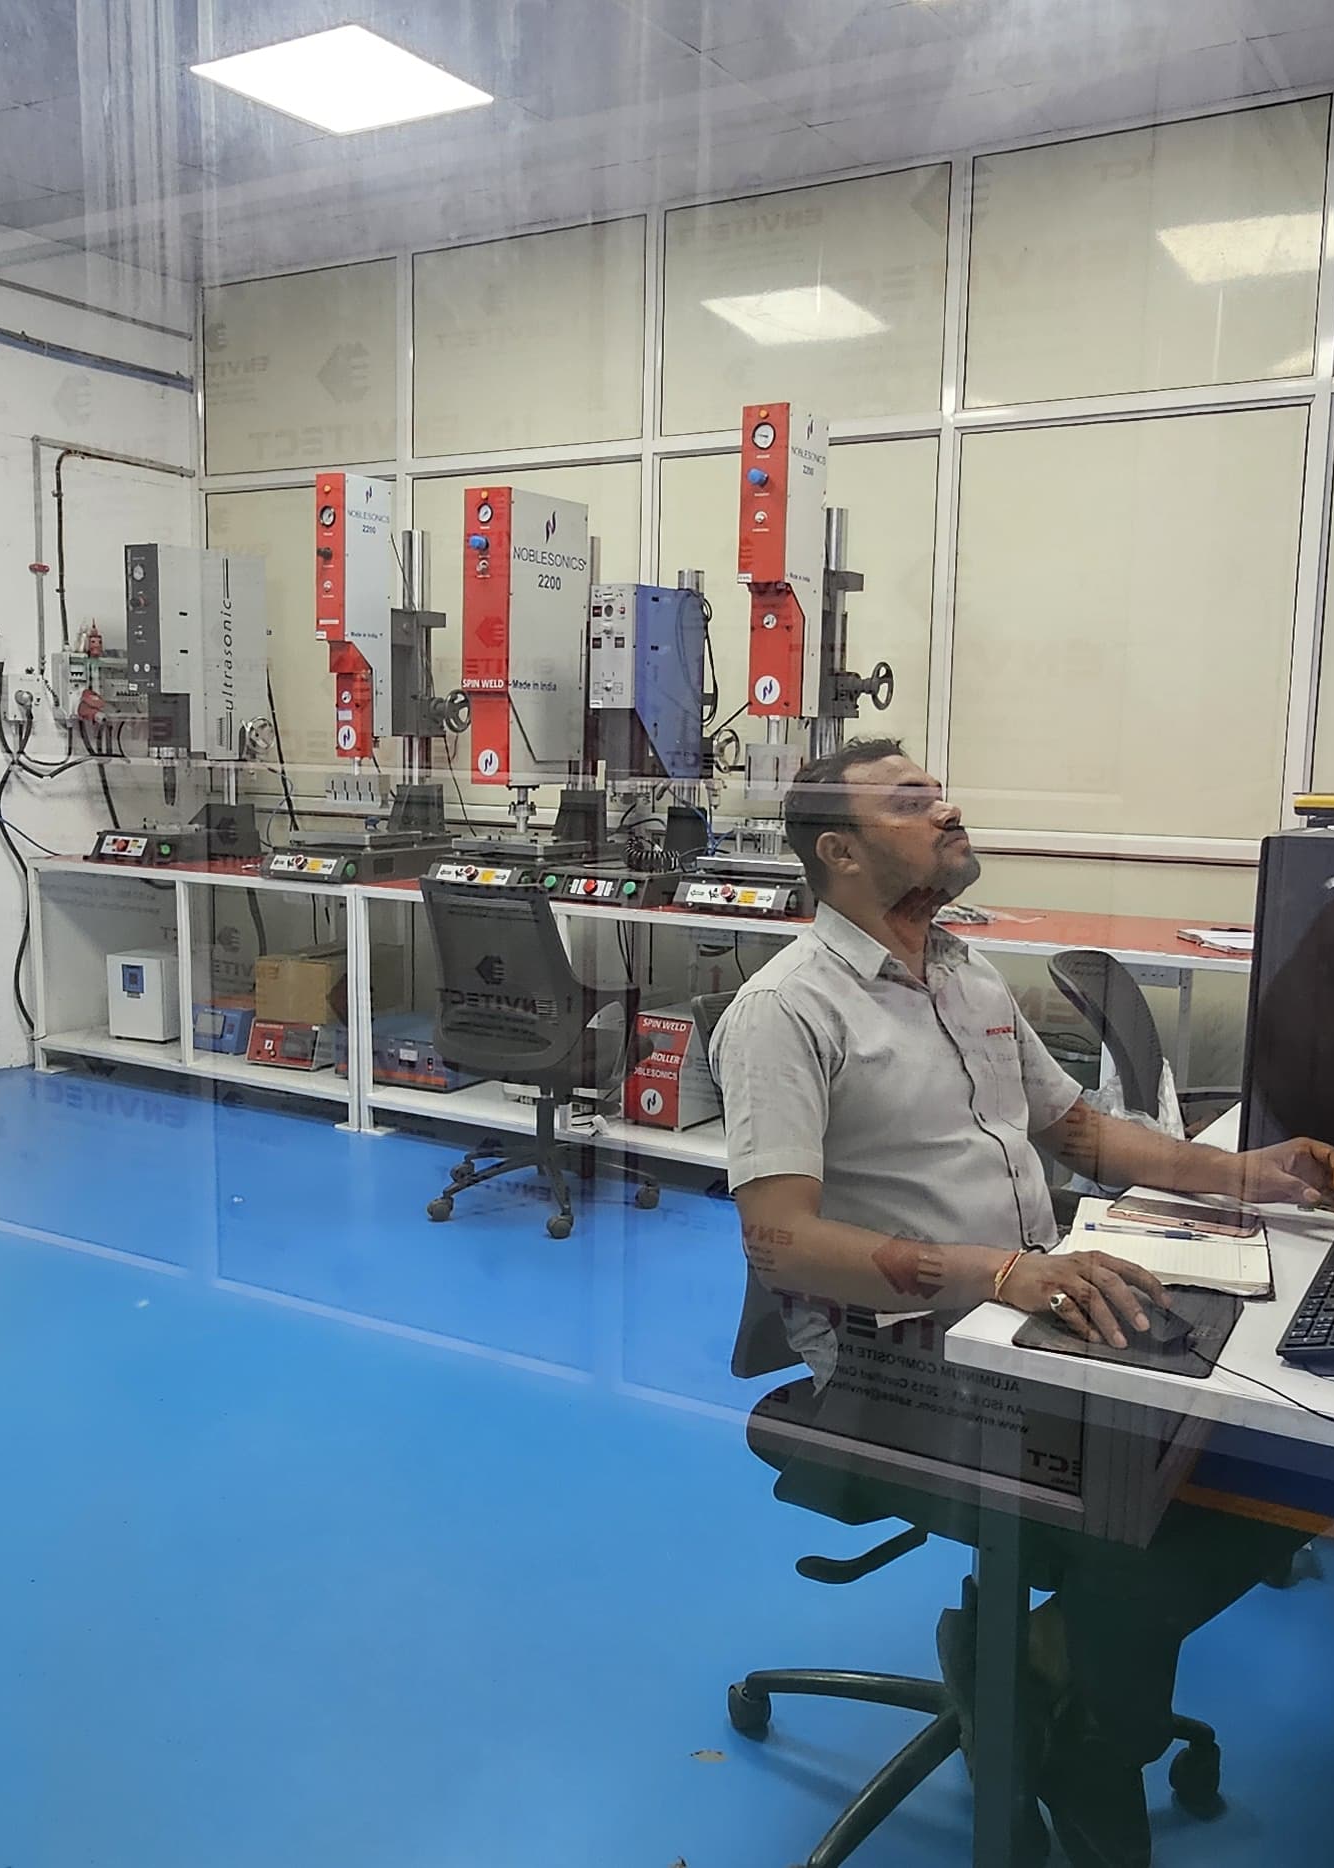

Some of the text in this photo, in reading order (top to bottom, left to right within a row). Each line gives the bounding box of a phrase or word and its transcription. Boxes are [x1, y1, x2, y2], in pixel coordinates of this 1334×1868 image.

[513, 546, 587, 572] NOBLESONICS
[538, 574, 562, 590] 2200
[220, 599, 235, 712] ultrasonic
[462, 678, 504, 689] SPIN WELD
[512, 679, 557, 692] Made in India
[642, 1017, 687, 1032] SPIN WELD
